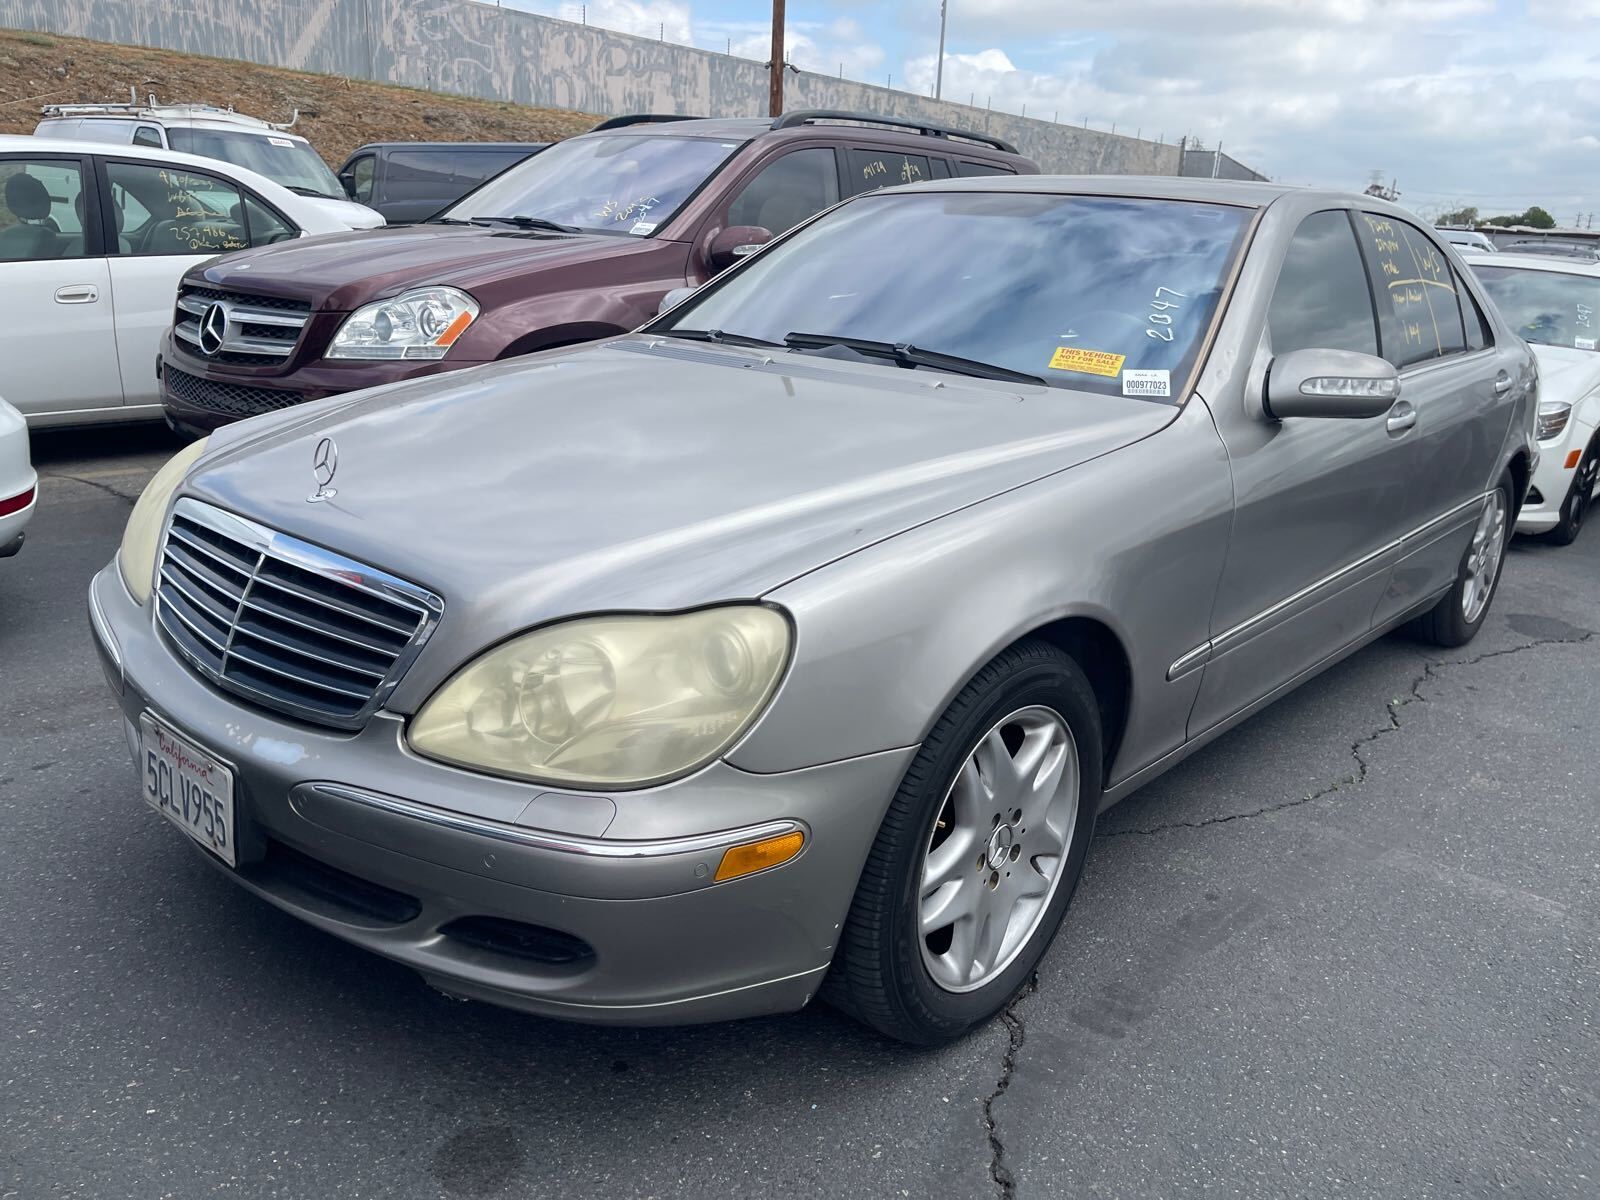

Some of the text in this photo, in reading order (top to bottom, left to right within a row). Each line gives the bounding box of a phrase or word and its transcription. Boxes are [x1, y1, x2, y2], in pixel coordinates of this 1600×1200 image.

[1145, 286, 1190, 342] 2047
[1083, 351, 1121, 361] VEHICLE
[1126, 380, 1167, 390] 000977023
[158, 733, 214, 786] California
[147, 750, 227, 847] 5CLV955
